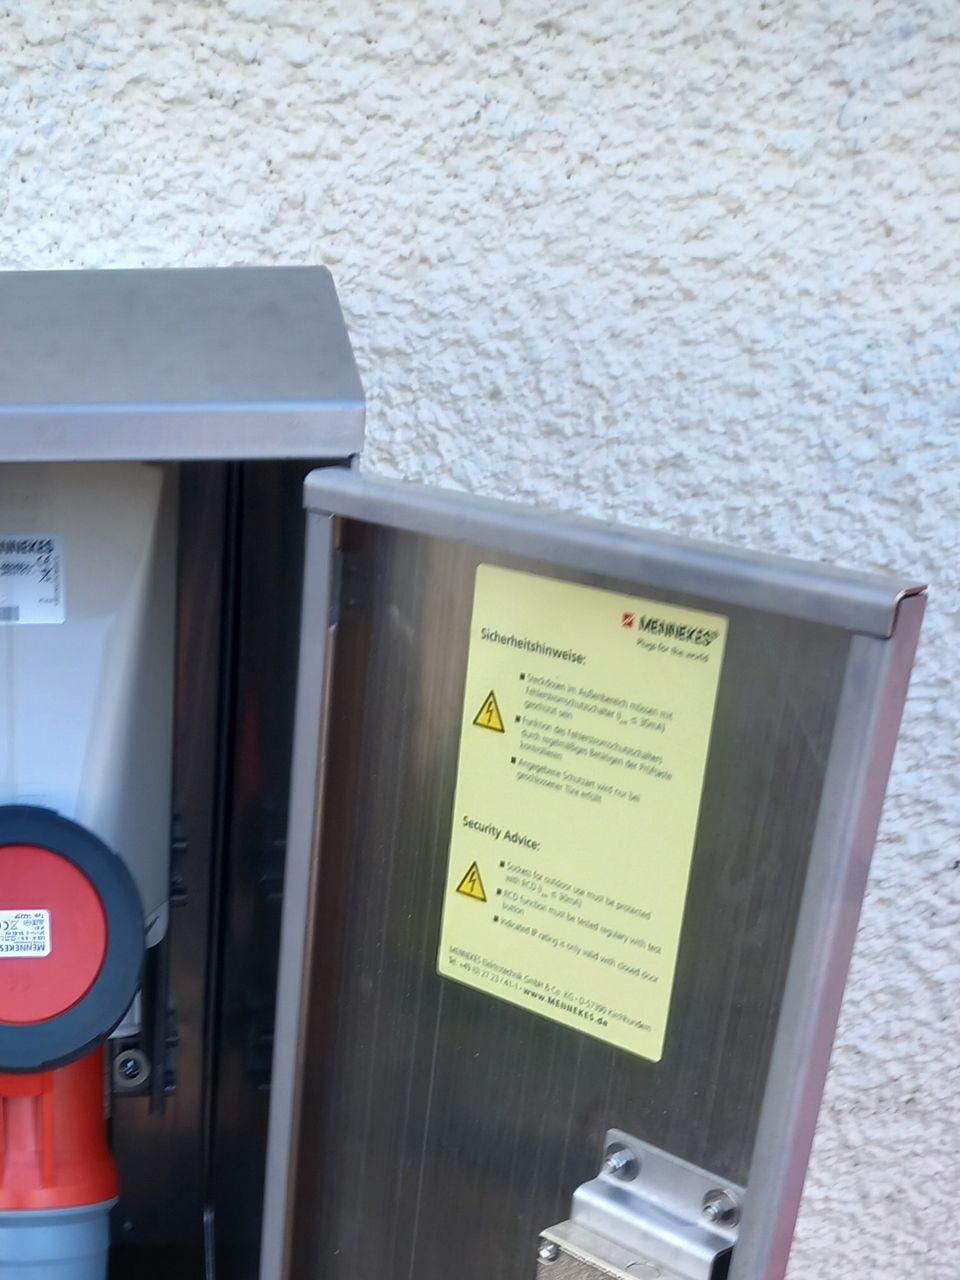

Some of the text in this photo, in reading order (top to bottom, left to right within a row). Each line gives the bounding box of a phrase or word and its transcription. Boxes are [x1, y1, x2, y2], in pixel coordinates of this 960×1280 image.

[481, 627, 586, 665] Sicherheitshinweise:
[463, 815, 542, 852] Security Advice:
